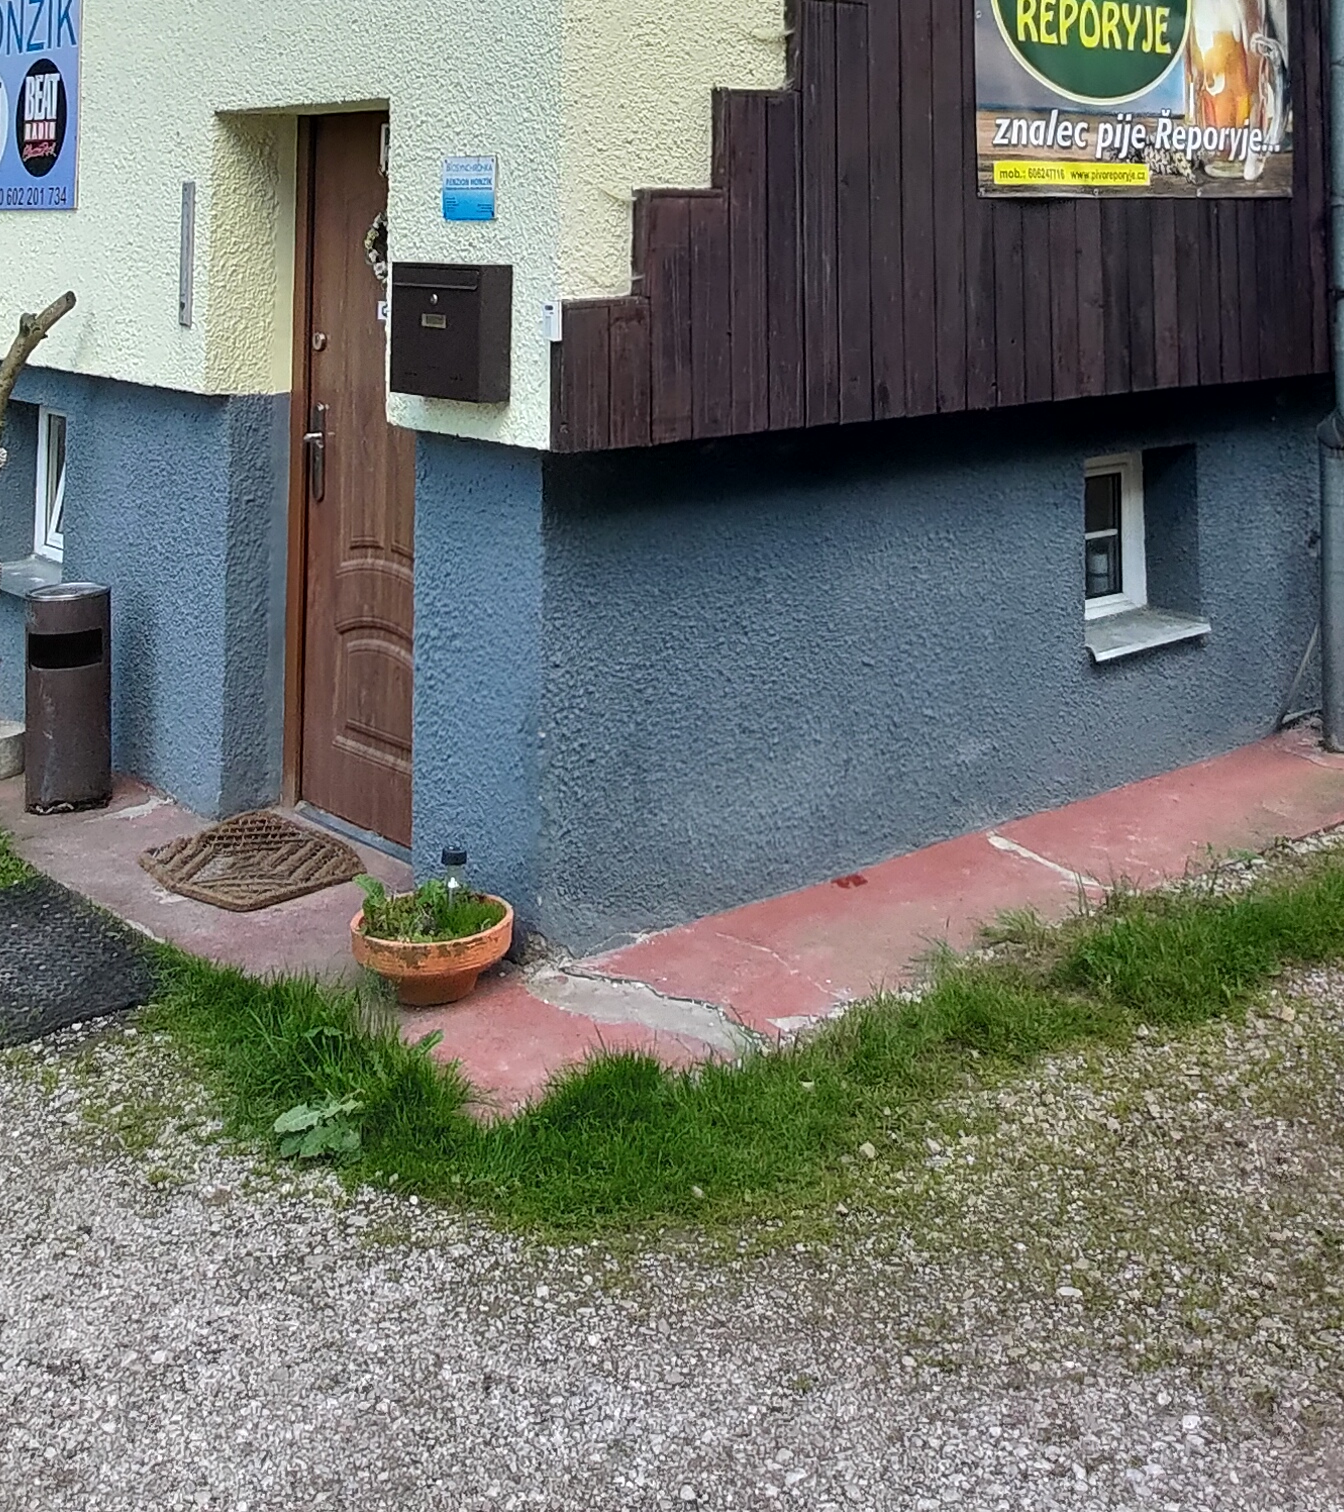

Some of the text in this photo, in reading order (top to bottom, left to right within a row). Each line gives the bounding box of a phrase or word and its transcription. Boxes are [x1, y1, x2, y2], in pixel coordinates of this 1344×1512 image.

[24, 73, 60, 120] BEAT
[23, 121, 57, 141] RADIO
[992, 108, 1281, 161] znalec pije Řeporyje...
[999, 168, 1026, 179] mob.:
[6, 187, 24, 206] 602
[26, 187, 45, 206] 201
[48, 186, 67, 205] 734
